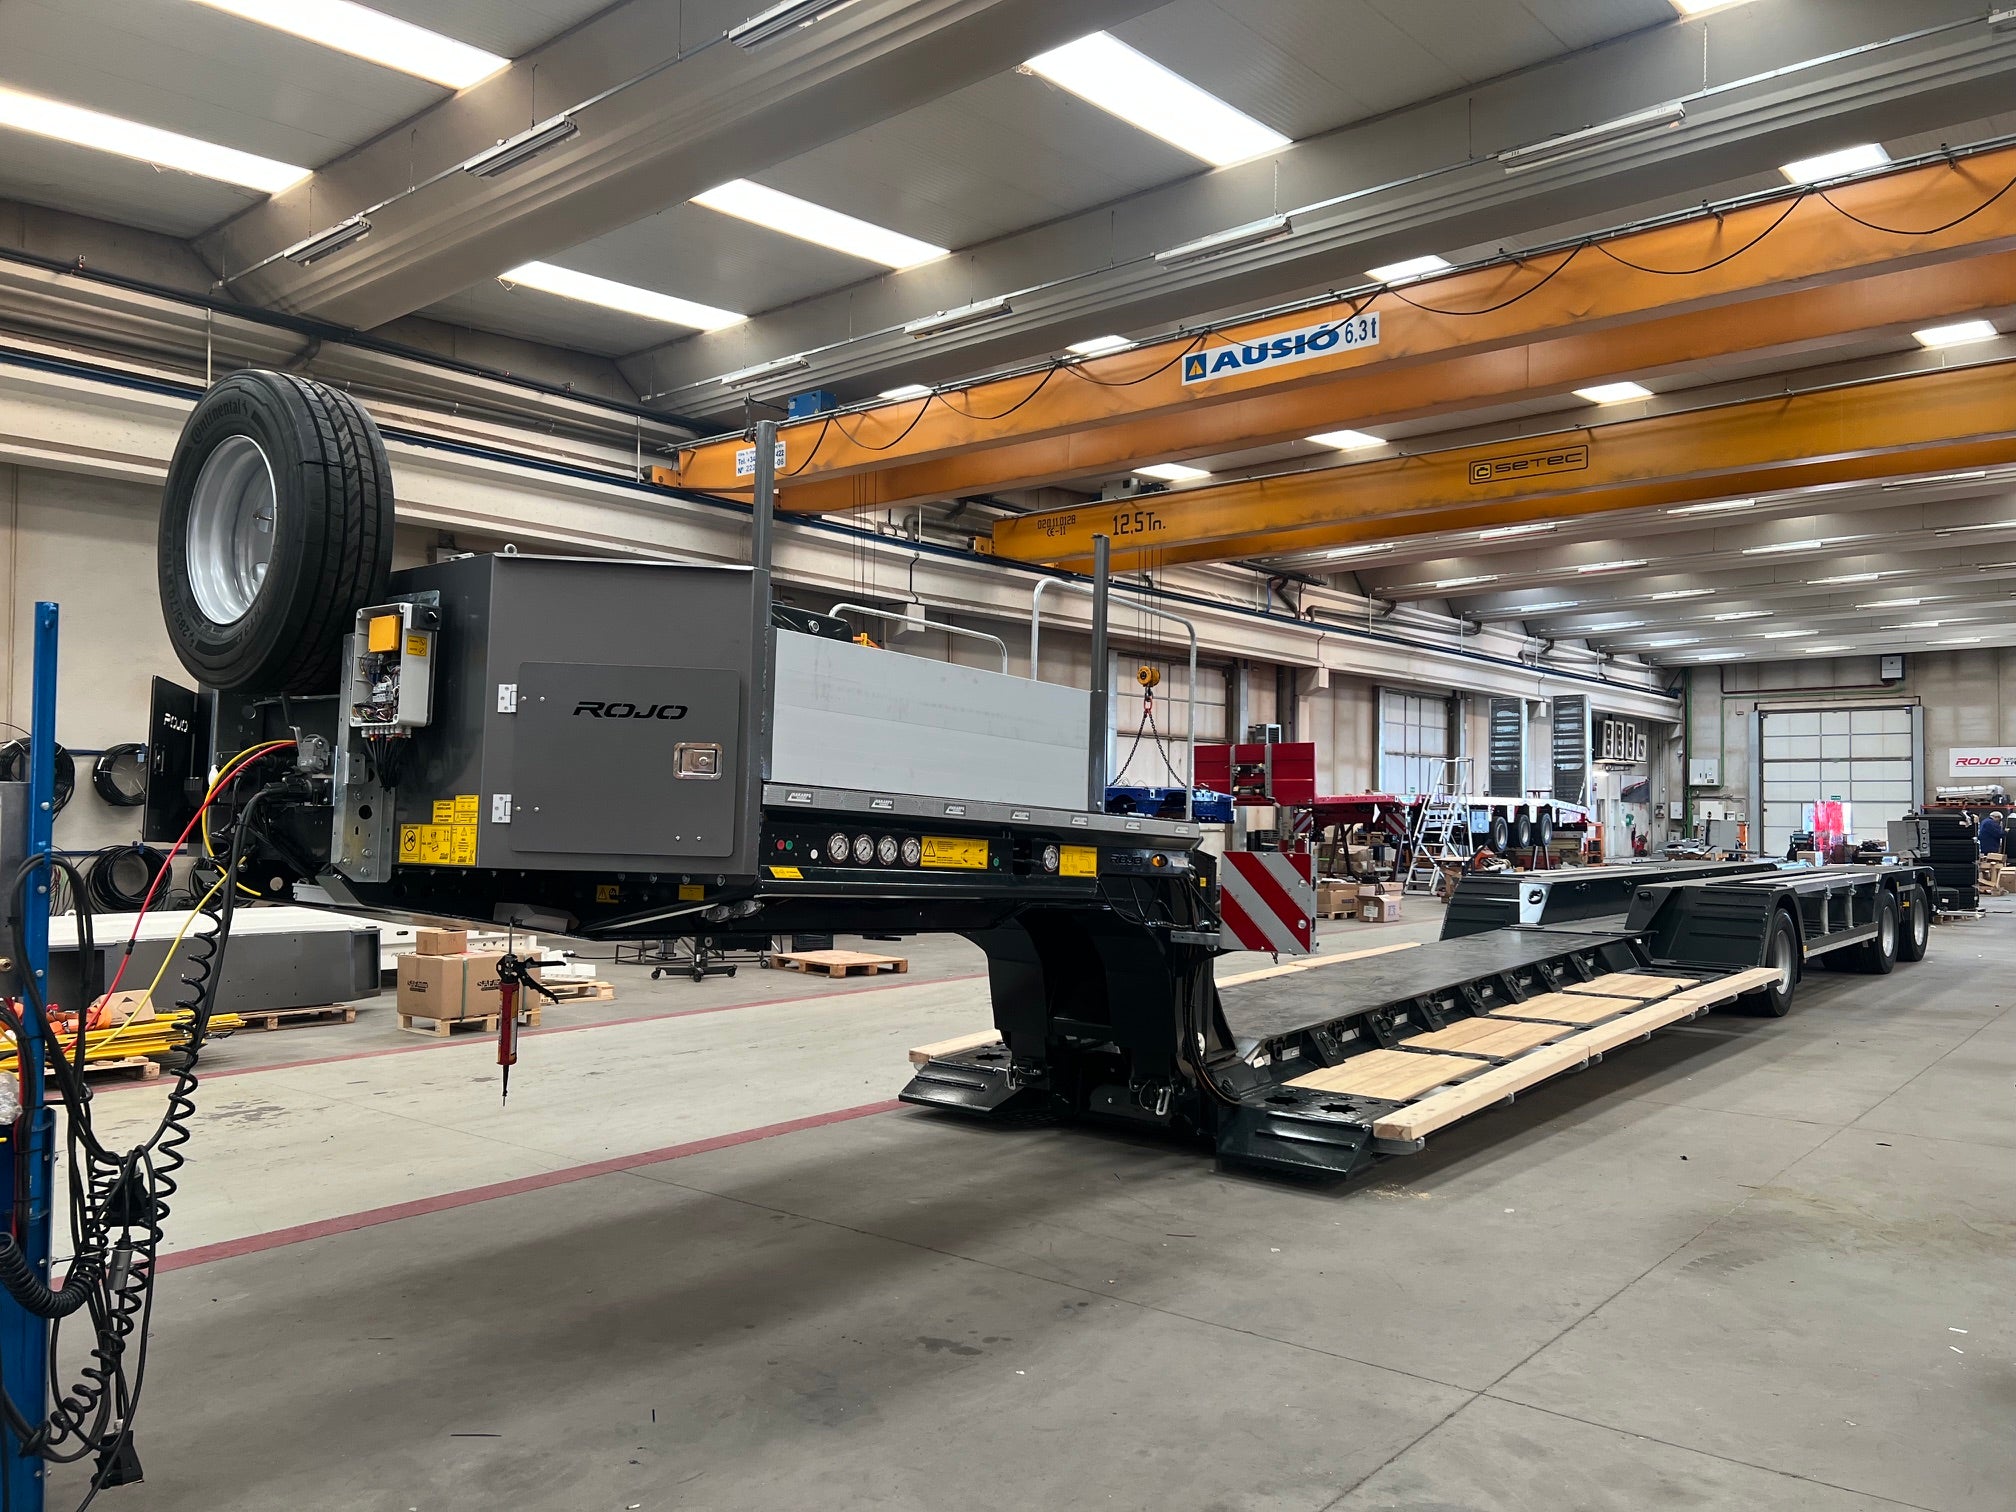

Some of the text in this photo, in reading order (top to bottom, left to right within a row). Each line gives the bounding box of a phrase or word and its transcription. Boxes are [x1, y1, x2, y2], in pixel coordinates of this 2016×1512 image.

[1210, 324, 1340, 374] AUSIÓ
[191, 398, 241, 445] Continental
[572, 701, 689, 720] ROJO
[1955, 757, 2001, 766] ROJO
